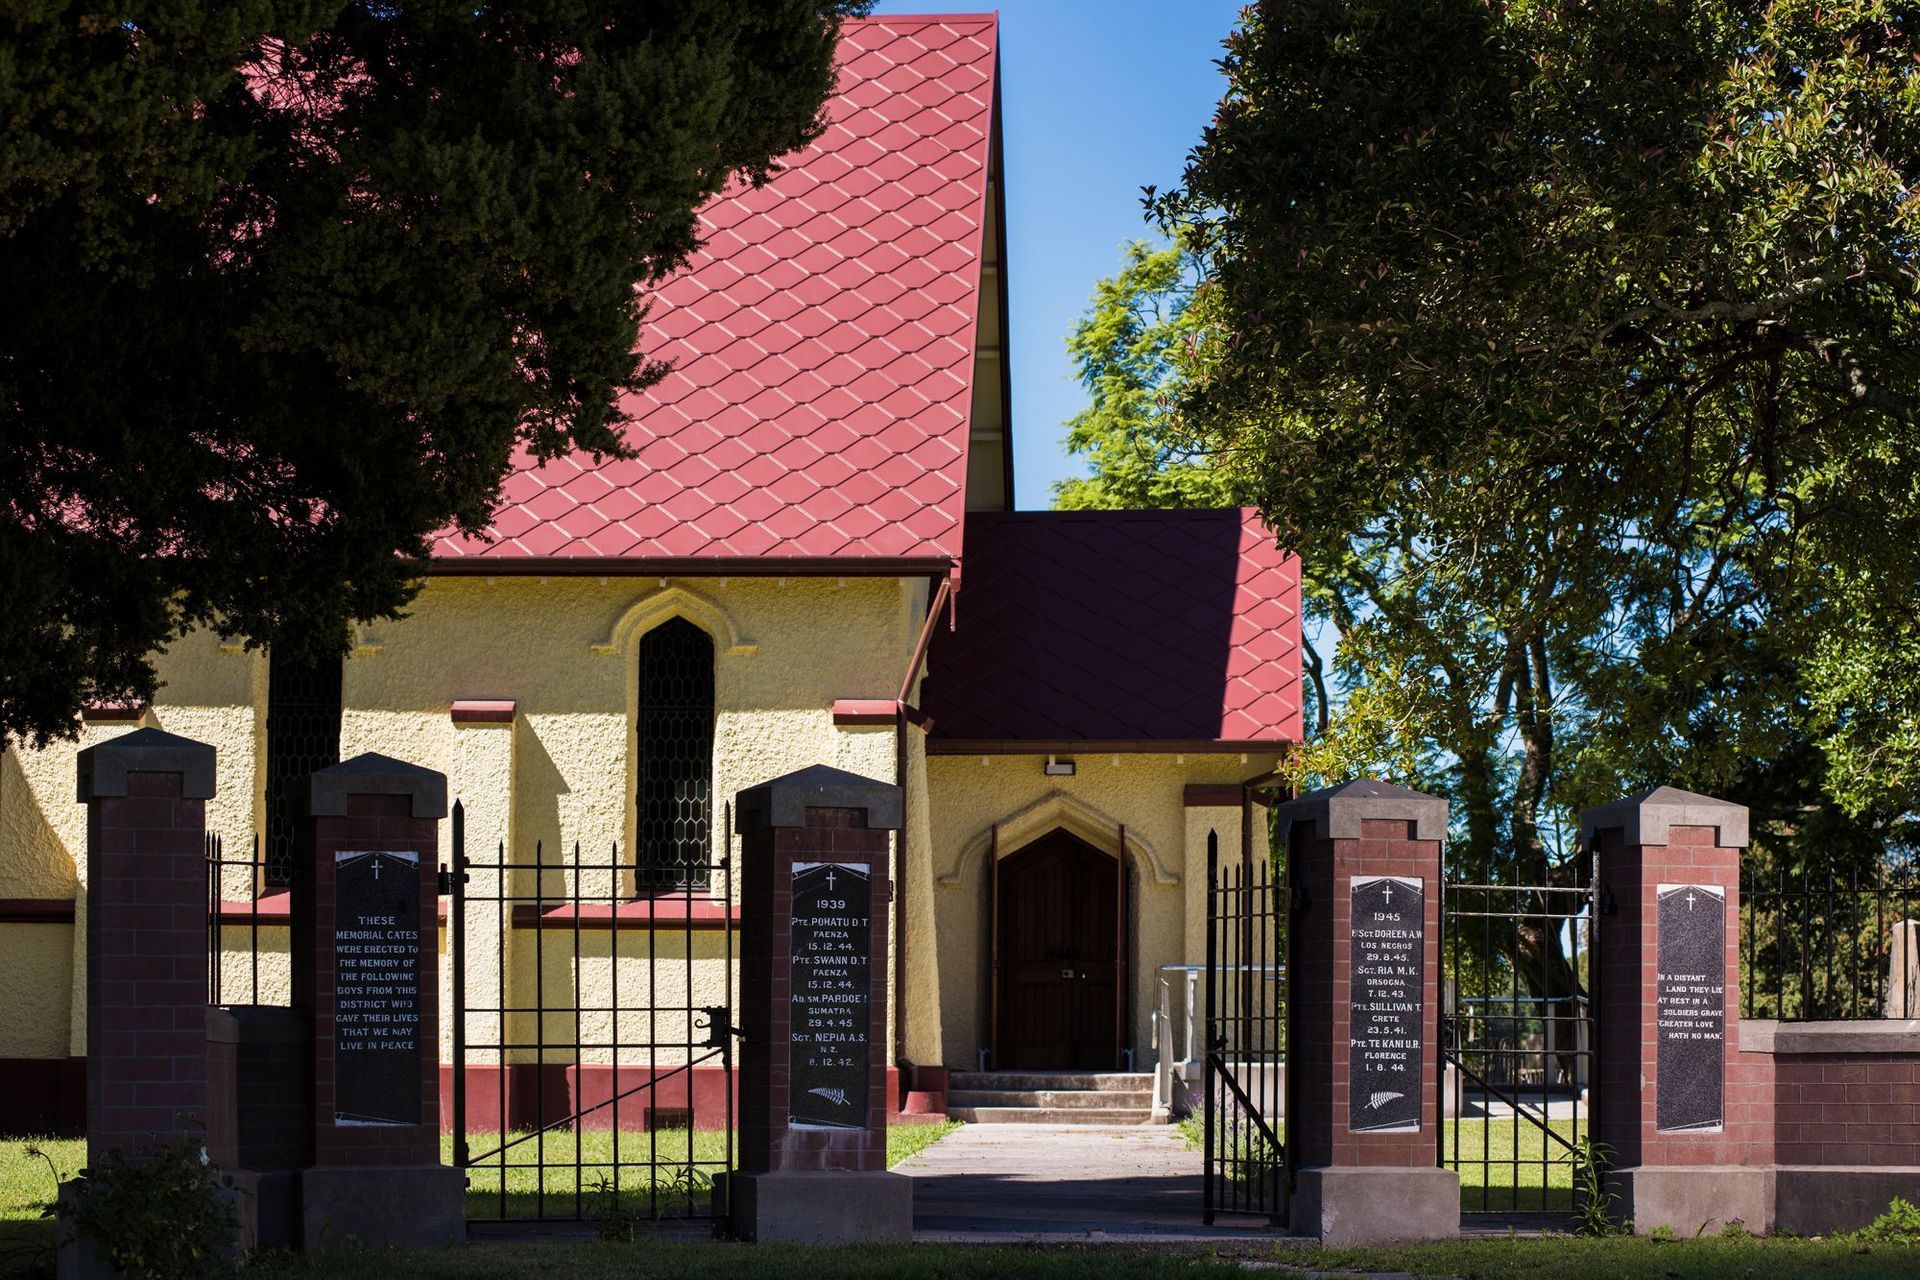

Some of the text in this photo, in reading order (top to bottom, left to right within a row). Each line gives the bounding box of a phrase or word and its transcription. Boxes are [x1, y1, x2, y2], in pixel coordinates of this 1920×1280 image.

[816, 900, 846, 909] 1939
[358, 916, 396, 925] THESE
[1374, 912, 1401, 921] 1945
[336, 931, 385, 940] MEMORIAL
[336, 945, 419, 954] WERE ERECTED TO
[1381, 942, 1413, 950] NEGROS
[341, 973, 415, 981] THE FOLLOWING
[1674, 974, 1706, 982] DISTANT
[337, 987, 417, 995] BOYS FROM THIS
[1689, 986, 1709, 994] THEY
[1711, 986, 1723, 994] LIE
[340, 1000, 387, 1009] DISTRICT
[1669, 997, 1691, 1005] REST
[1663, 1009, 1699, 1017] SOLDIERS
[336, 1014, 419, 1022] GAVE THEIR LIVES
[1371, 1015, 1400, 1023] CRETE
[342, 1028, 413, 1036] THAT WE MAY
[1668, 1032, 1689, 1040] HATH
[1691, 1032, 1702, 1040] NO
[815, 1033, 846, 1042] NEPIA
[340, 1042, 415, 1050] LIVE IN PEACE
[1368, 1039, 1381, 1048] TE
[1382, 1039, 1404, 1048] KANI
[1364, 1052, 1407, 1060] FLORENCE
